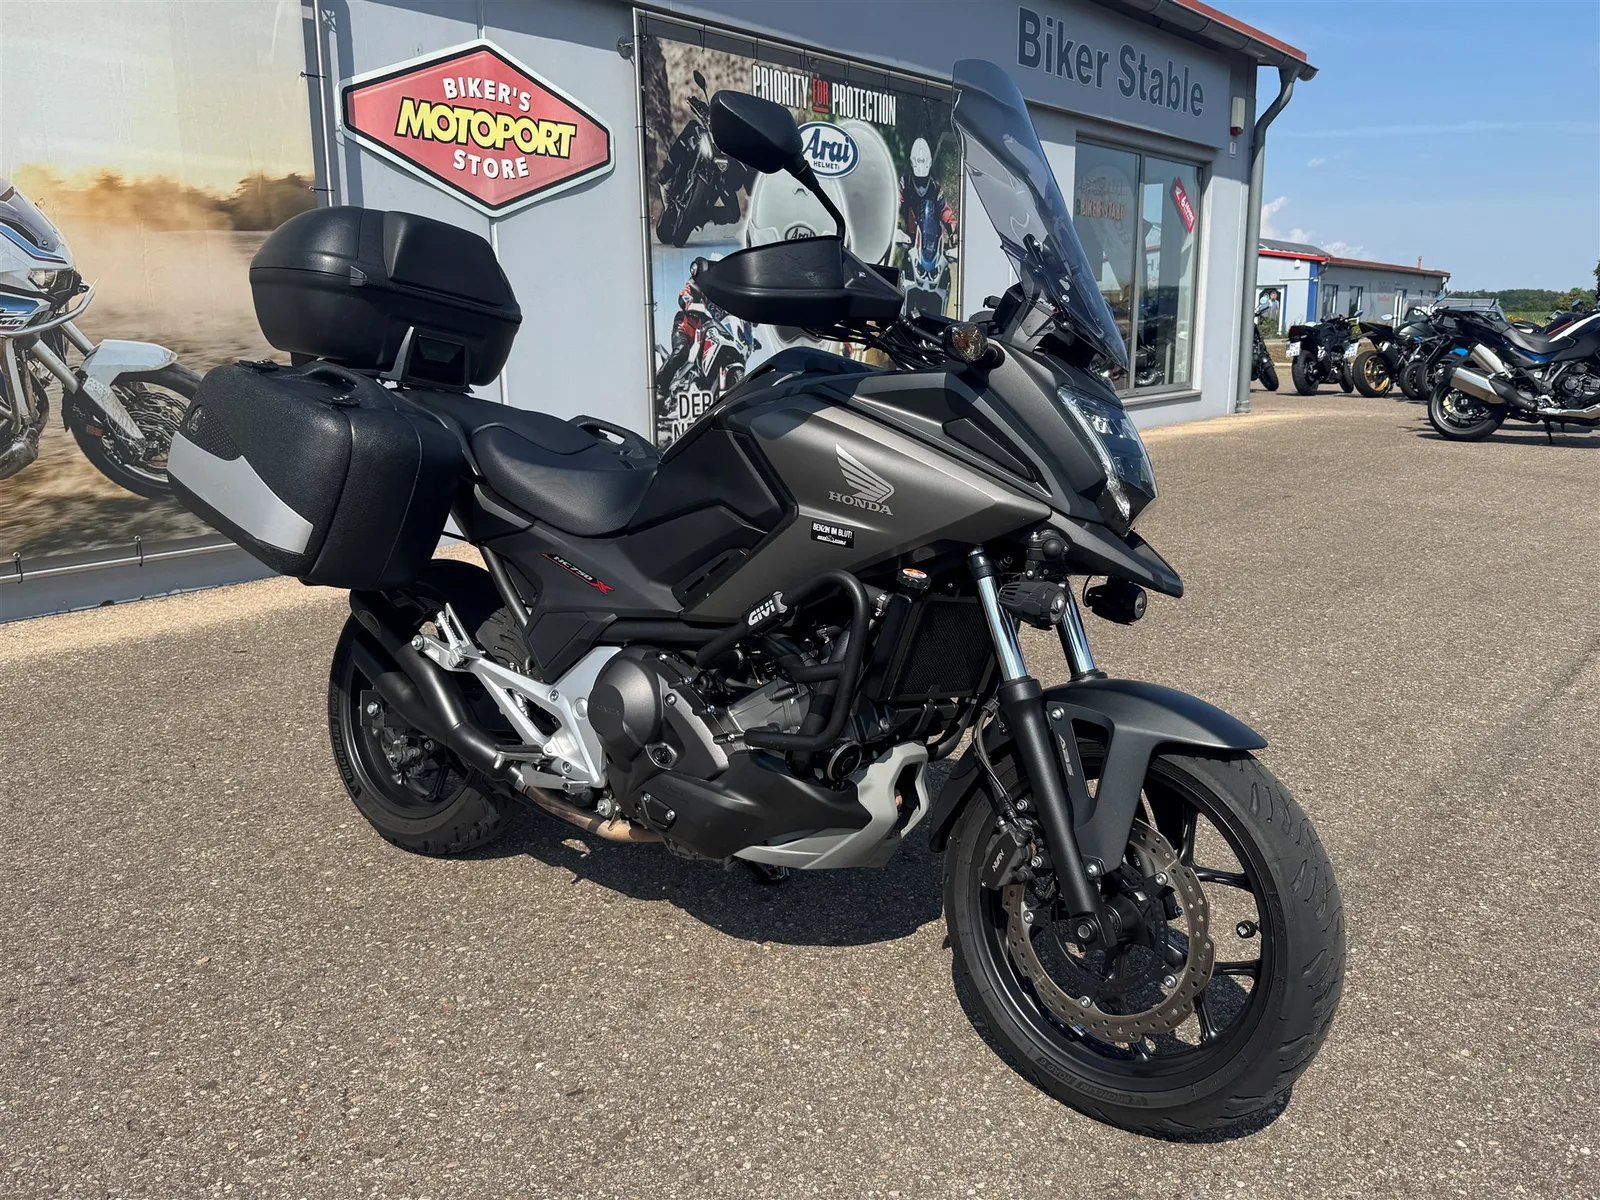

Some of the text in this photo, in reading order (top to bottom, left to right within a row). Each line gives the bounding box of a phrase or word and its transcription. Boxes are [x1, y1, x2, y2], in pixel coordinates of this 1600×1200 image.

[1017, 5, 1204, 117] Biker Stable
[442, 76, 532, 113] BIKER'S
[752, 64, 896, 127] PRIORITY FOR PROTECTION
[395, 97, 577, 159] MOTOPORT
[802, 128, 850, 163] Arai
[452, 149, 530, 180] STORE
[828, 491, 894, 516] HONDA
[747, 599, 776, 626] GIVI
